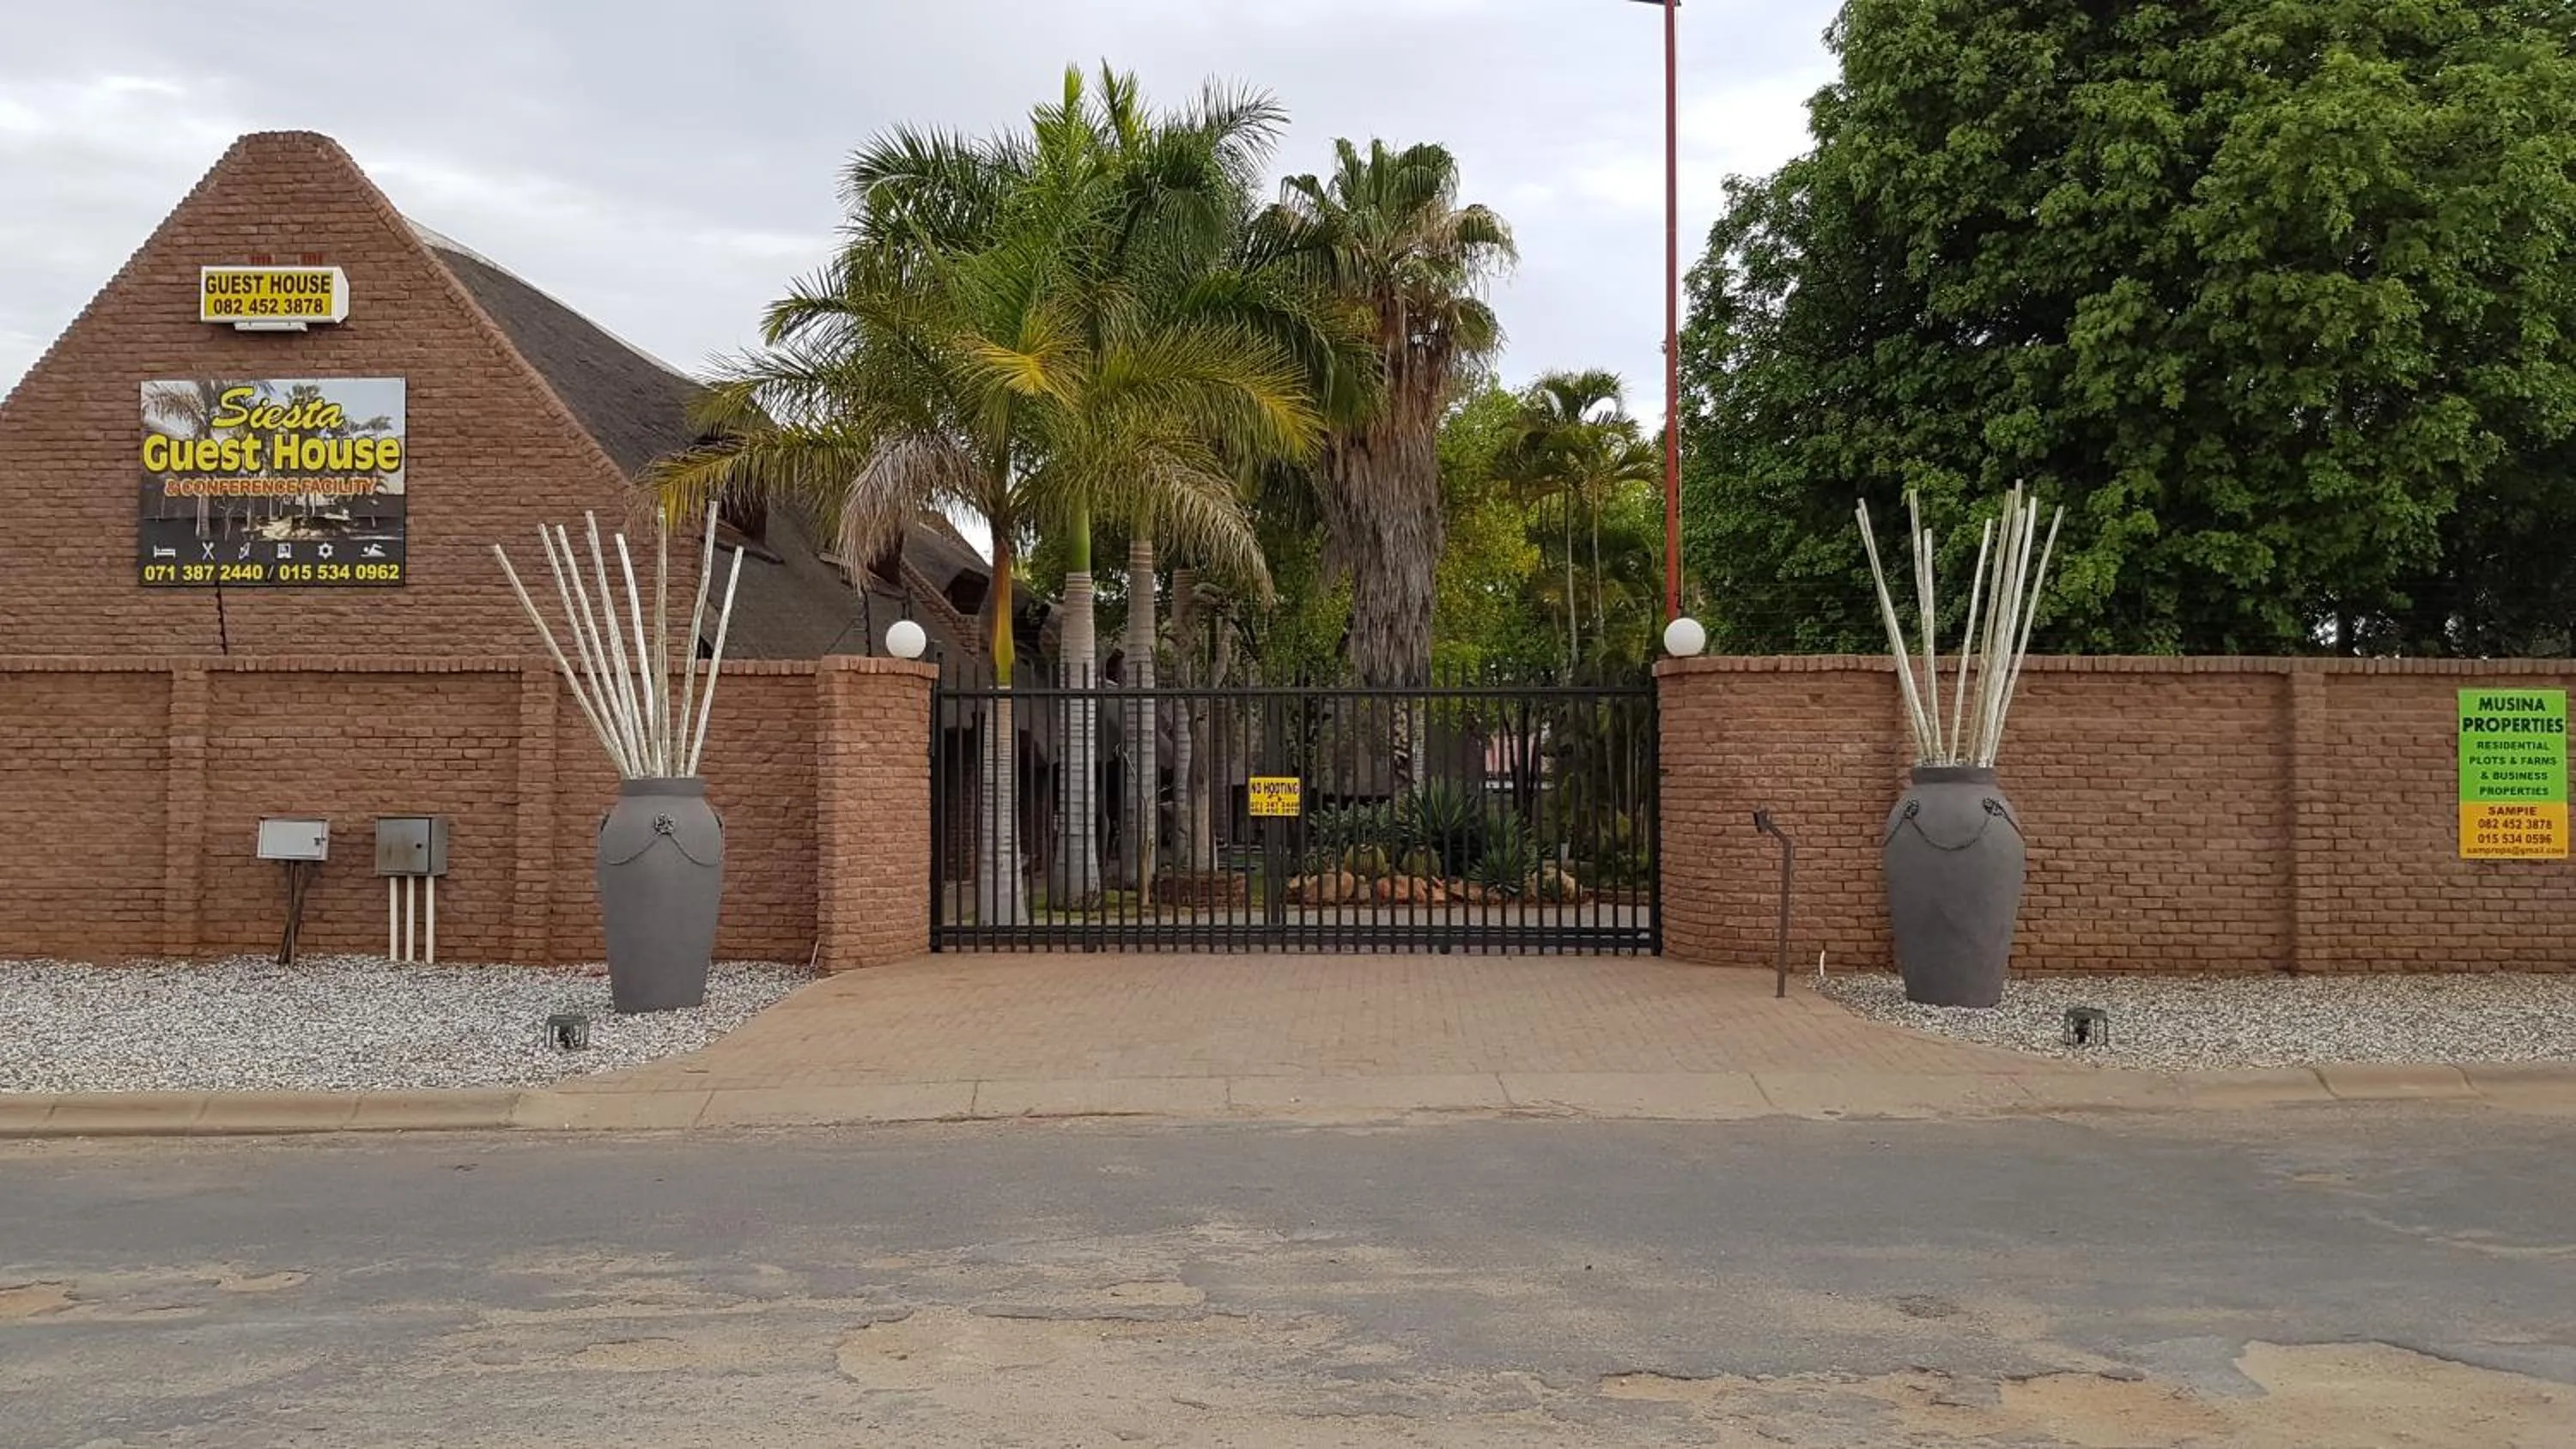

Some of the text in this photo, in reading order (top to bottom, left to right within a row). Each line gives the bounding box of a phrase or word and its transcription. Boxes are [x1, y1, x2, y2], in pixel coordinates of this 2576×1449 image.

[205, 275, 331, 294] GUEST HOUSE
[214, 299, 324, 314] 082 452 3878
[212, 386, 344, 429] Siesta
[143, 432, 402, 472] Guest House
[165, 477, 377, 496] & CONFERENCE FACILITY
[144, 564, 400, 580] 071 387 2440 / 015 534 0962
[2478, 697, 2546, 712] MUSINA
[2462, 717, 2564, 733] PROPERTIES
[2476, 741, 2550, 751] RESIDENTIAL
[2469, 756, 2557, 766] PLOTS & FARMS
[2481, 772, 2548, 780] & BUSINESS
[1264, 782, 1299, 795] HOOTING
[2479, 786, 2549, 796] PROPERTIES
[2488, 806, 2537, 815] SAMPIE
[2502, 818, 2522, 829] 452
[2477, 834, 2499, 844] 015
[2502, 834, 2522, 844] 534
